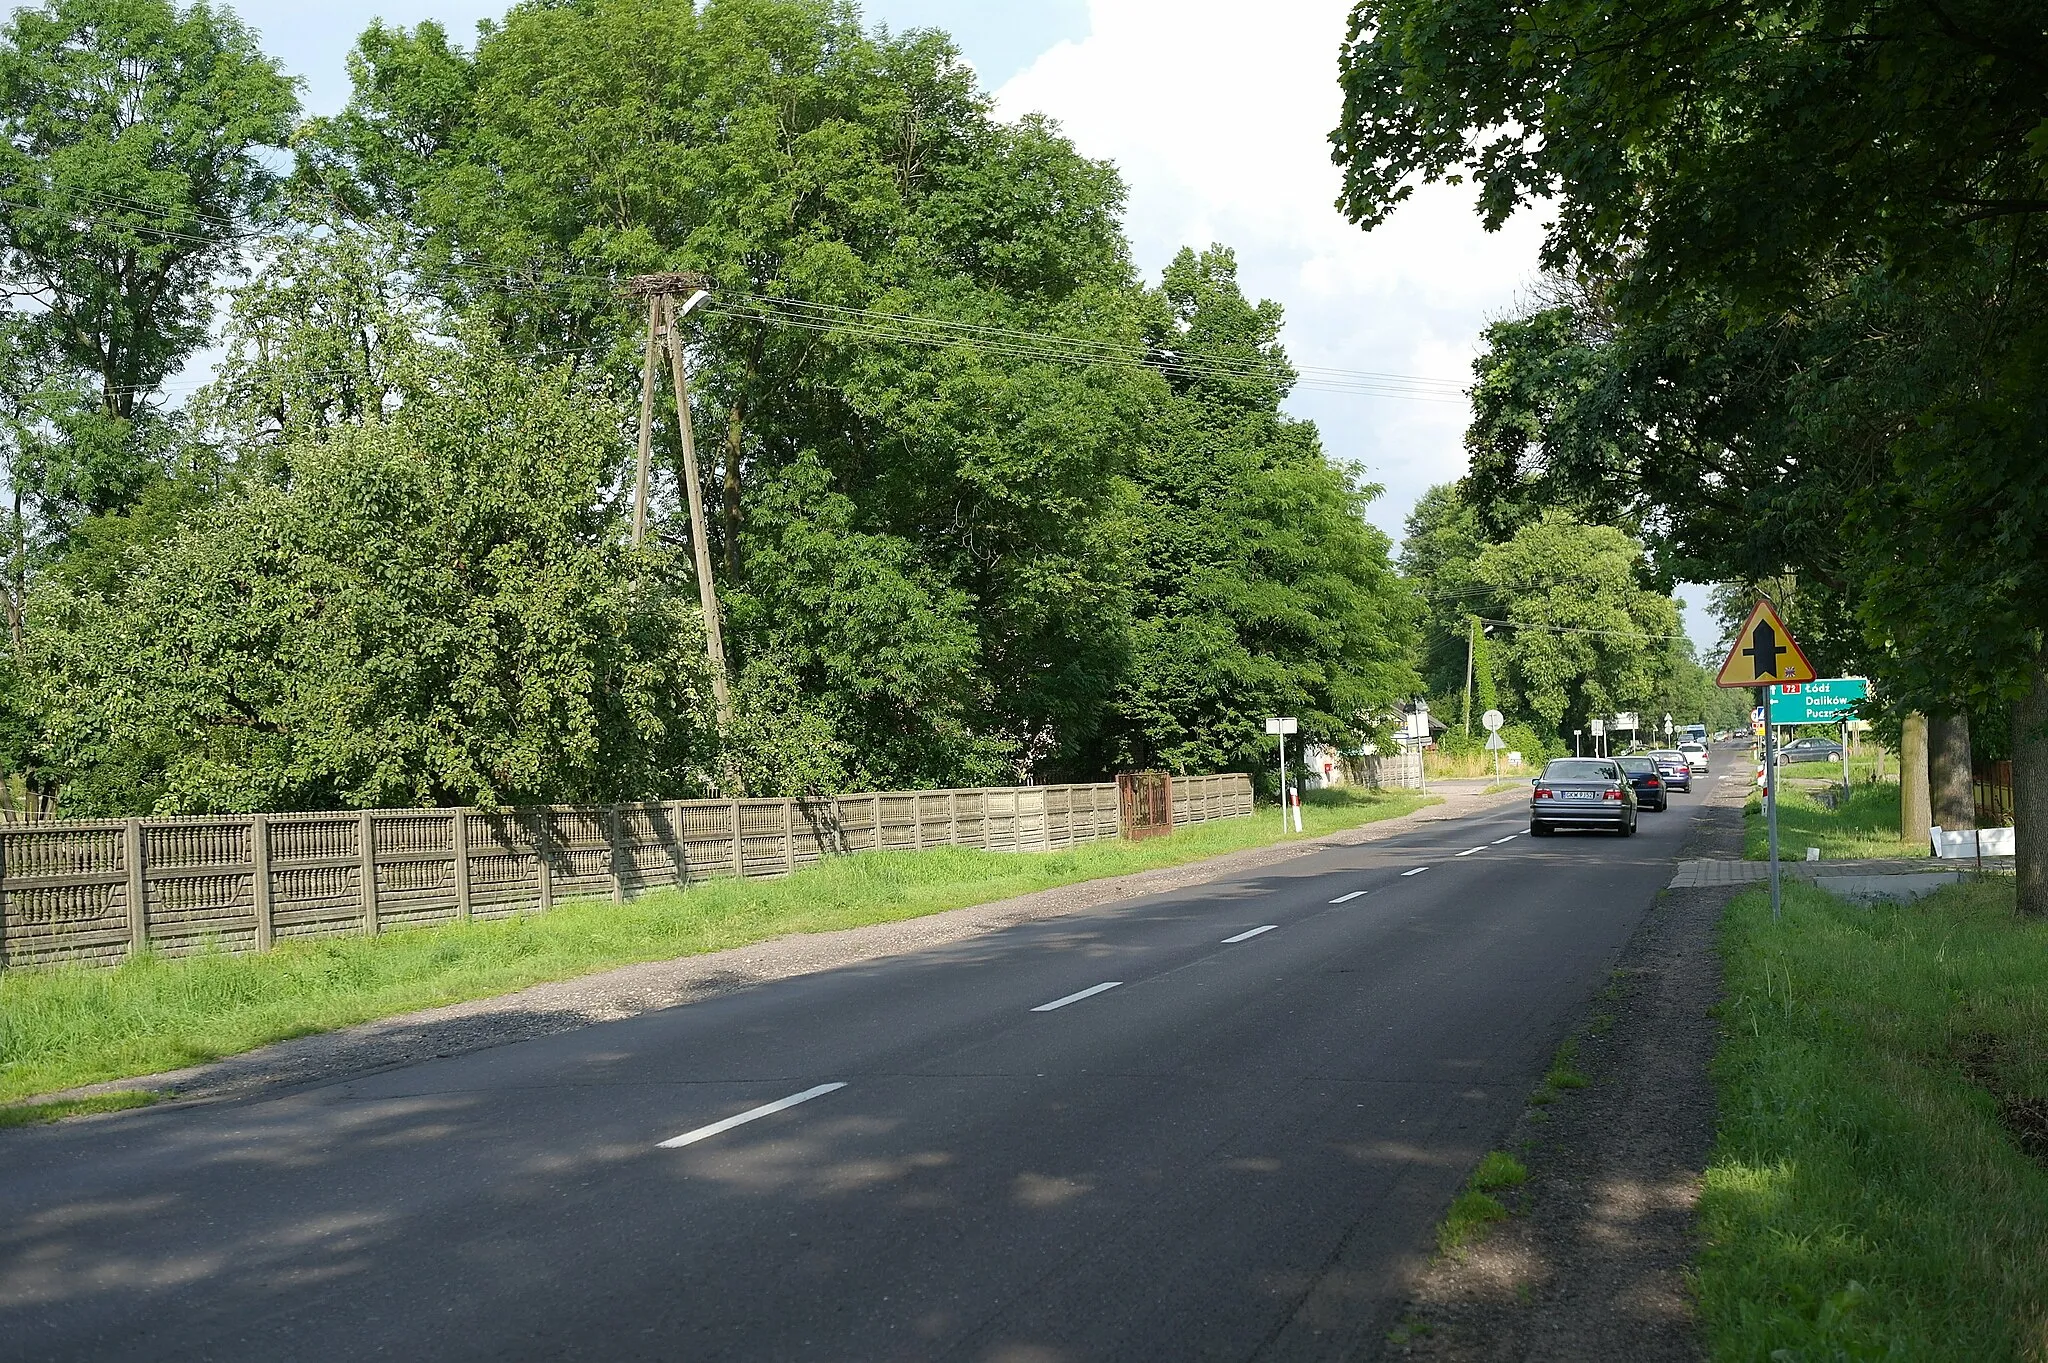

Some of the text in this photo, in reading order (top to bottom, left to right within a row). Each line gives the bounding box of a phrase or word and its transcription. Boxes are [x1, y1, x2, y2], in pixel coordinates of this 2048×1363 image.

[1805, 683, 1830, 693] Łódź
[1806, 696, 1847, 705] Dalików
[1806, 708, 1850, 718] Puczni
